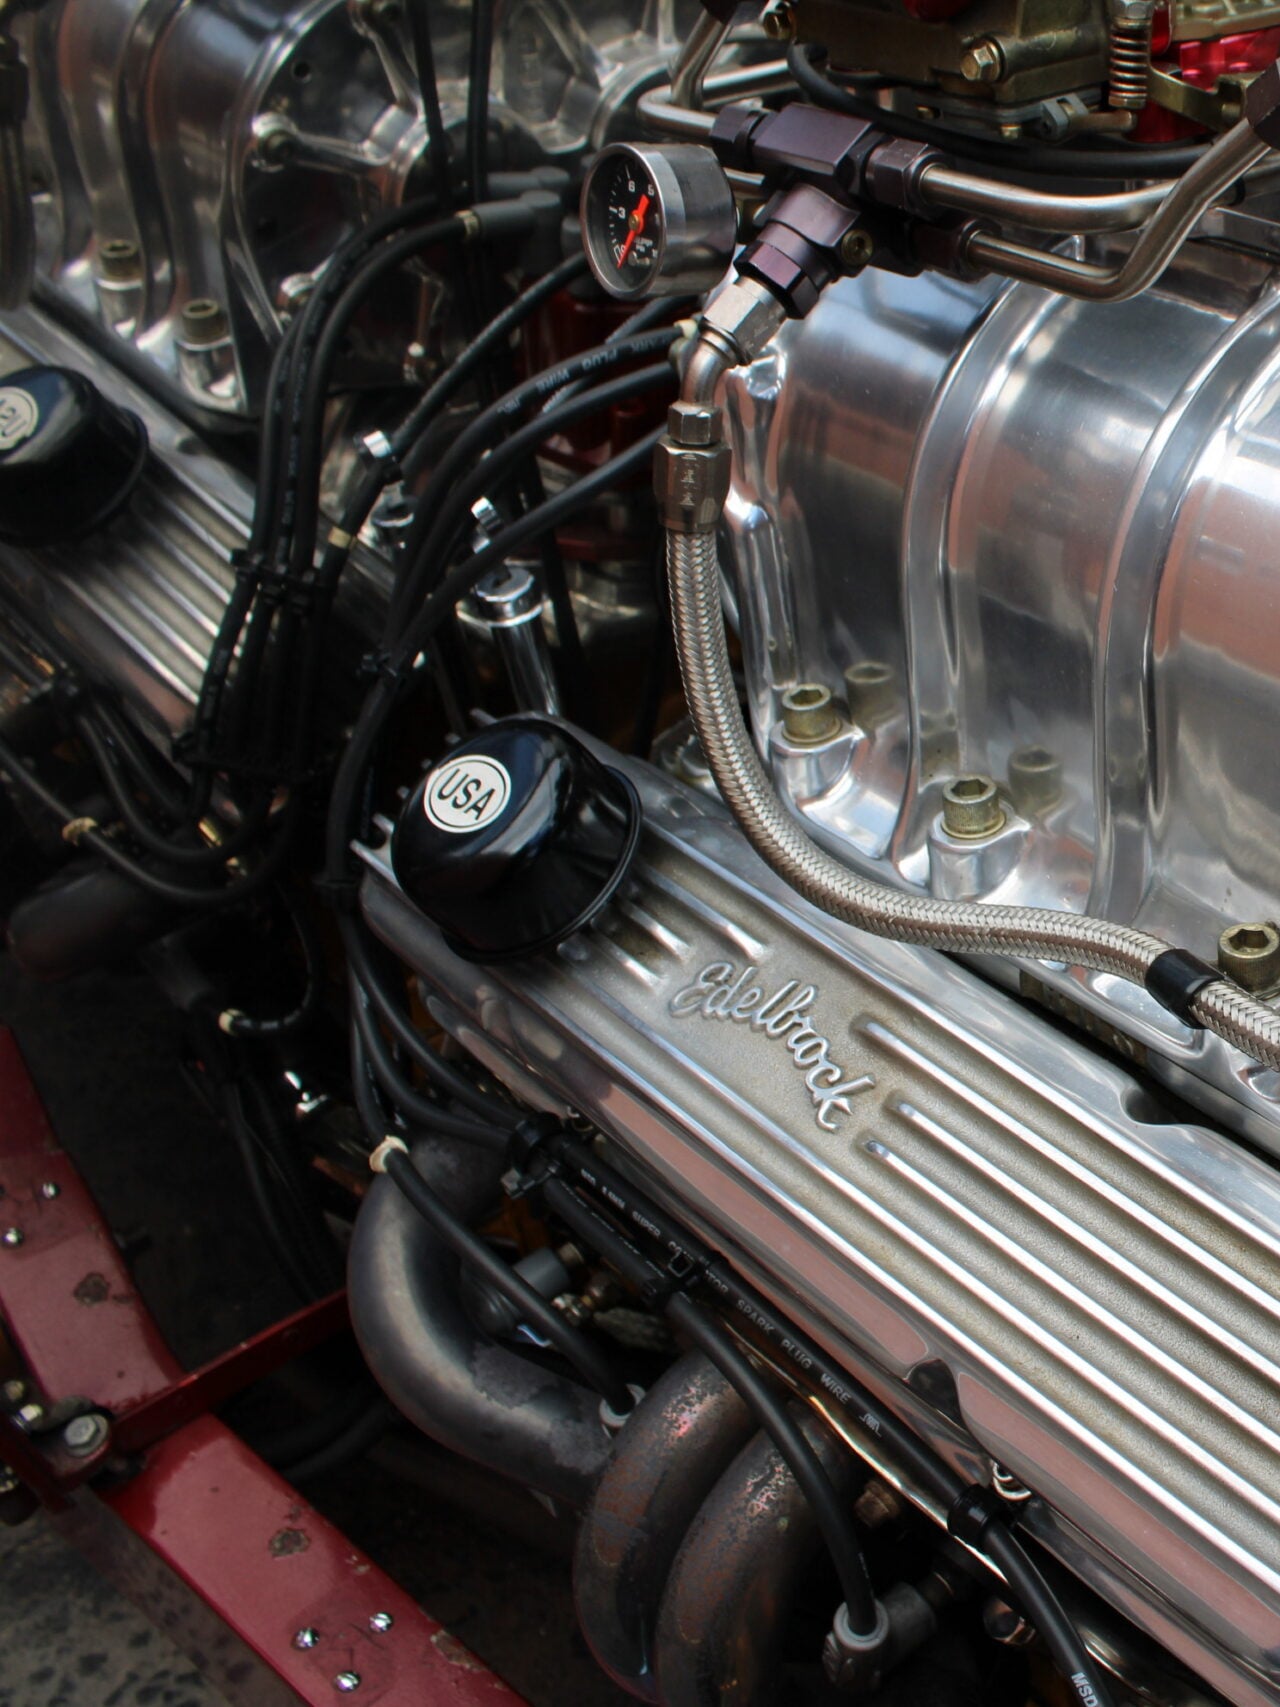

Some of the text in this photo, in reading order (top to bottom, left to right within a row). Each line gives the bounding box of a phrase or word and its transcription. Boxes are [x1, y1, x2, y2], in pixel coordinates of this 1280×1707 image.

[628, 180, 636, 192] 6
[617, 207, 626, 219] 3
[437, 768, 495, 821] USA
[669, 961, 876, 1133] Edelbrock
[632, 1210, 661, 1238] SUPER
[737, 1299, 775, 1334] SPARK
[780, 1338, 812, 1370] PLUG
[819, 1372, 852, 1405] WIRE
[1071, 1671, 1099, 1707] MSD
